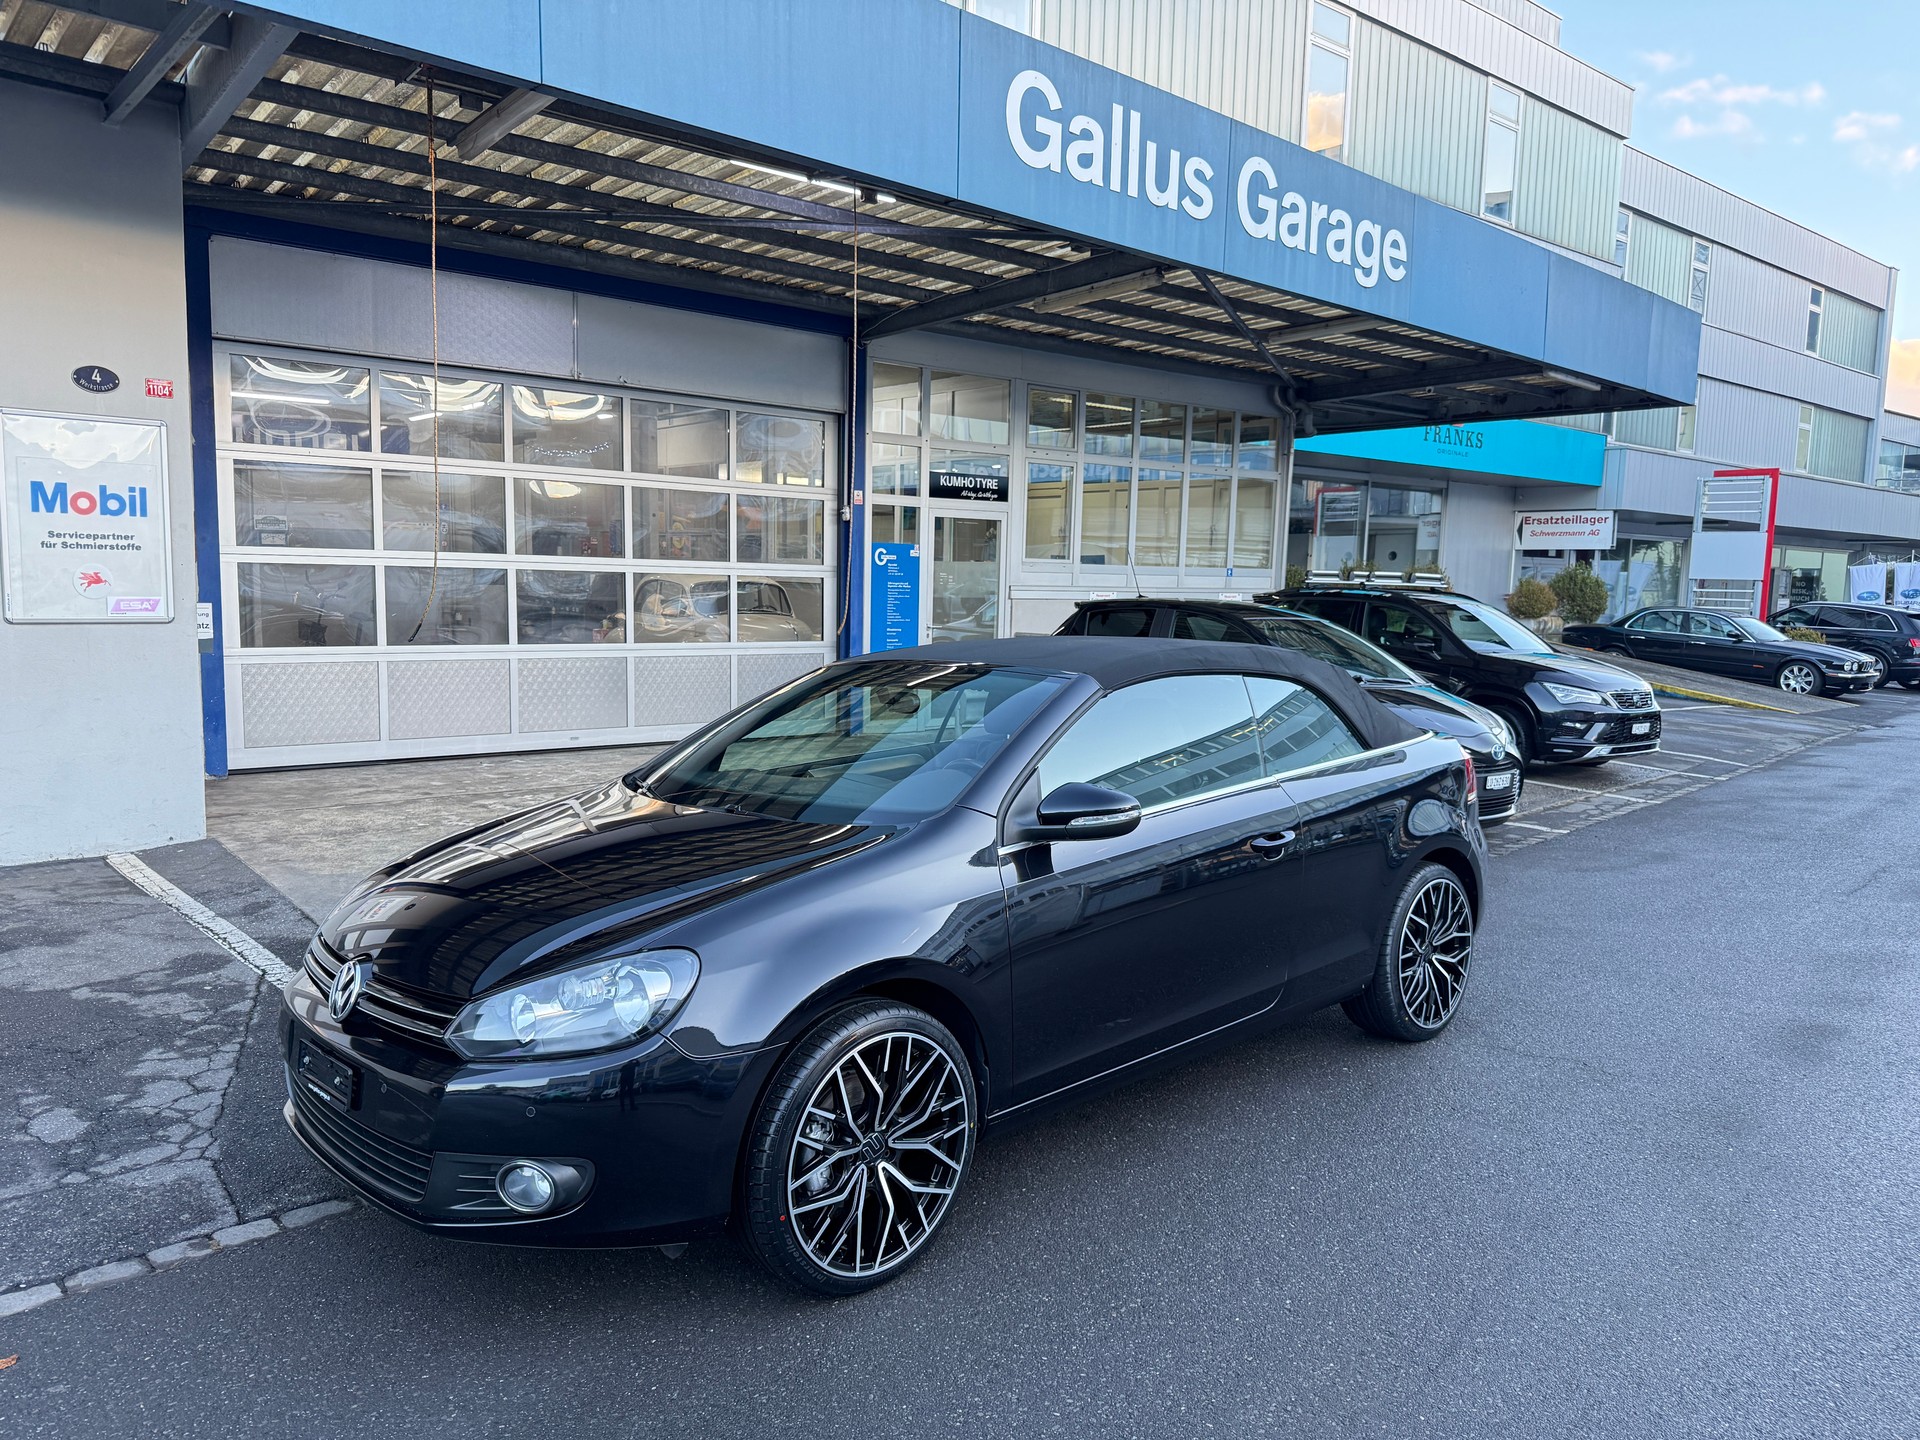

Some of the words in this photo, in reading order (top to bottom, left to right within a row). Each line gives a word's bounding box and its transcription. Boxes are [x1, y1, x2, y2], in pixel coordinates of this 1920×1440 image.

[1005, 69, 1214, 220] Gallus
[1237, 155, 1408, 289] Garage
[91, 368, 102, 384] 4
[148, 384, 169, 397] 1104
[1423, 425, 1484, 449] FRANKS
[940, 475, 975, 488] KUMHO
[975, 477, 999, 490] TYRE
[30, 480, 148, 518] Mobil
[1524, 514, 1610, 526] Ersatzteillager
[47, 530, 136, 542] Servicepartner
[1529, 529, 1586, 538] Schwerzmann
[1587, 529, 1601, 537] AG
[40, 541, 58, 549] für
[60, 541, 142, 551] Schmierstoffe
